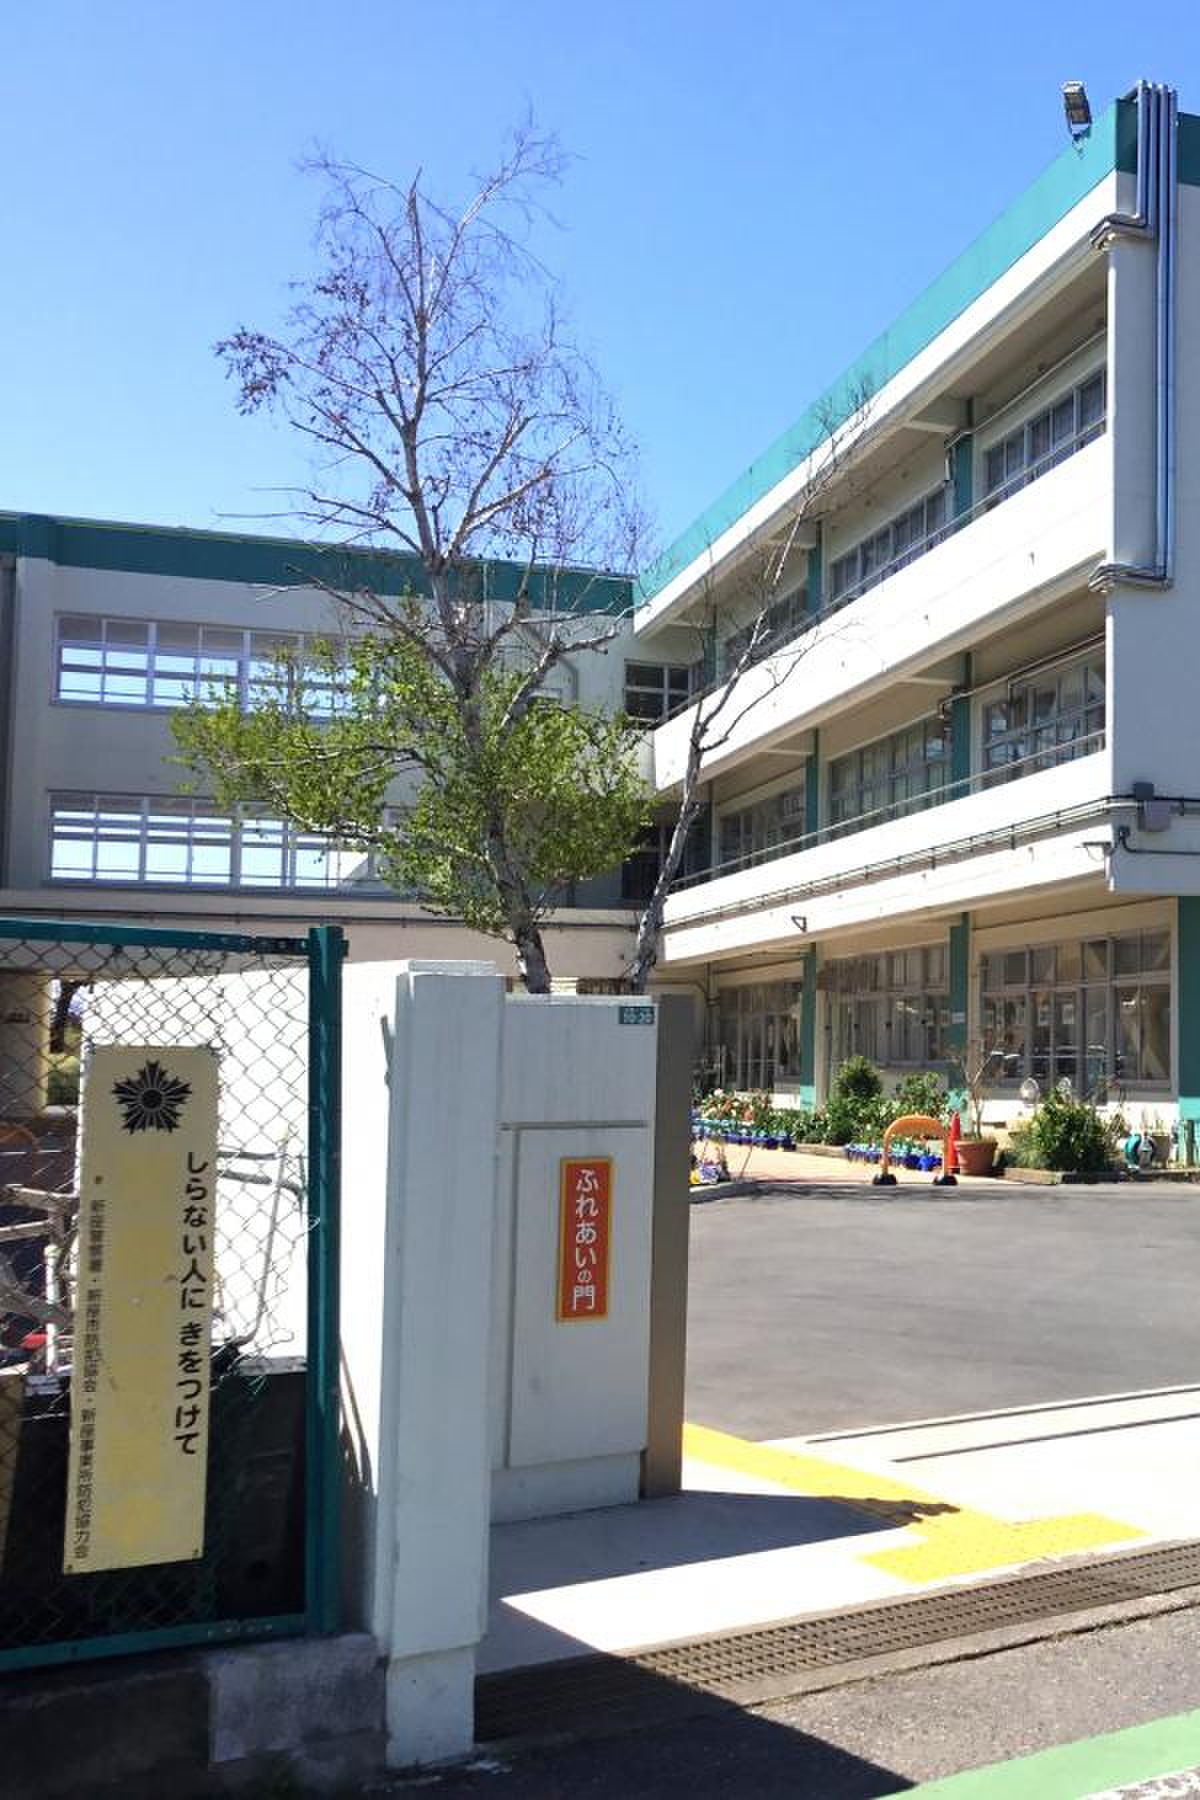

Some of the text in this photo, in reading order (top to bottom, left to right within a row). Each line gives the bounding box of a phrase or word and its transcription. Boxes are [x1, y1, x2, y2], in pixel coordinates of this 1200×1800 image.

[573, 1168, 599, 1311] ふれあいの門
